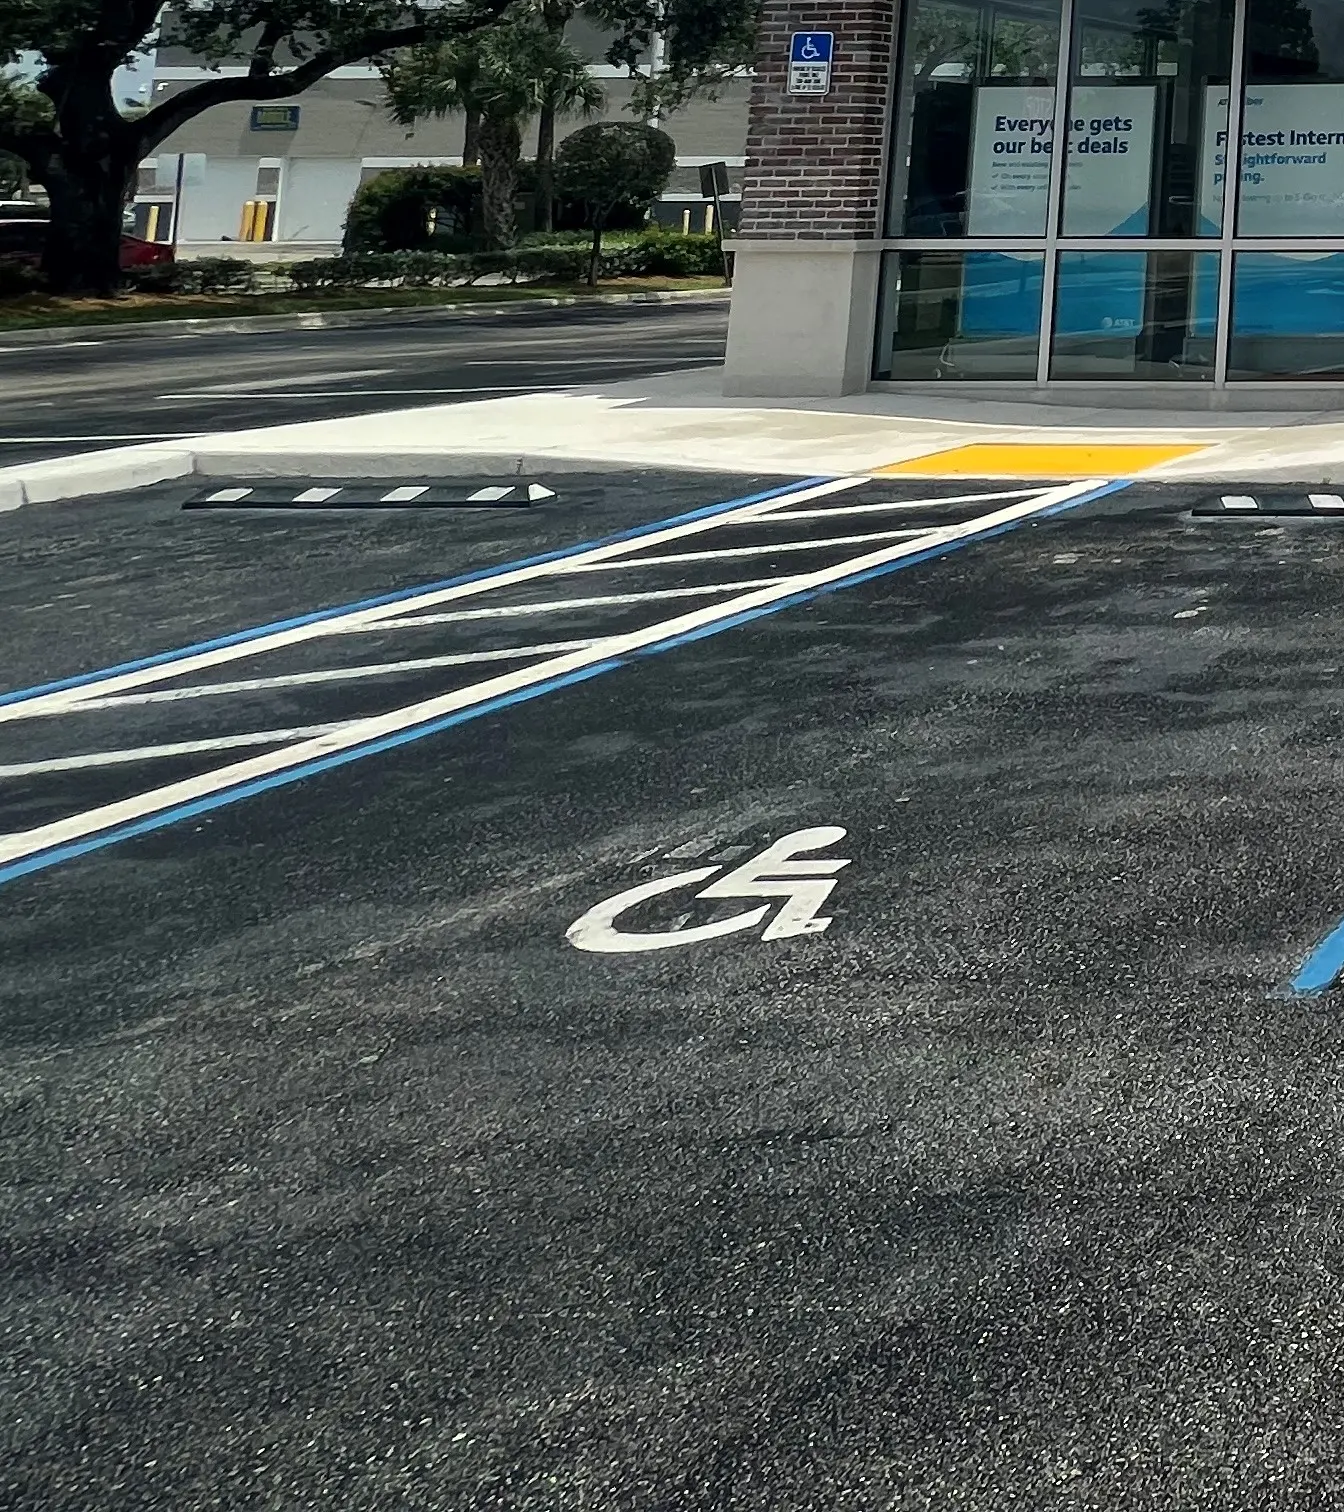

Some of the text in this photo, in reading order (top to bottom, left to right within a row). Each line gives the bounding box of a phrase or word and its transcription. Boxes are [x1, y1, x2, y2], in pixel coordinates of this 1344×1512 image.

[1090, 116, 1133, 136] gets
[993, 140, 1027, 154] our
[1077, 137, 1129, 154] deals
[1216, 131, 1285, 146] Fstest
[1214, 152, 1327, 168] Sightforward
